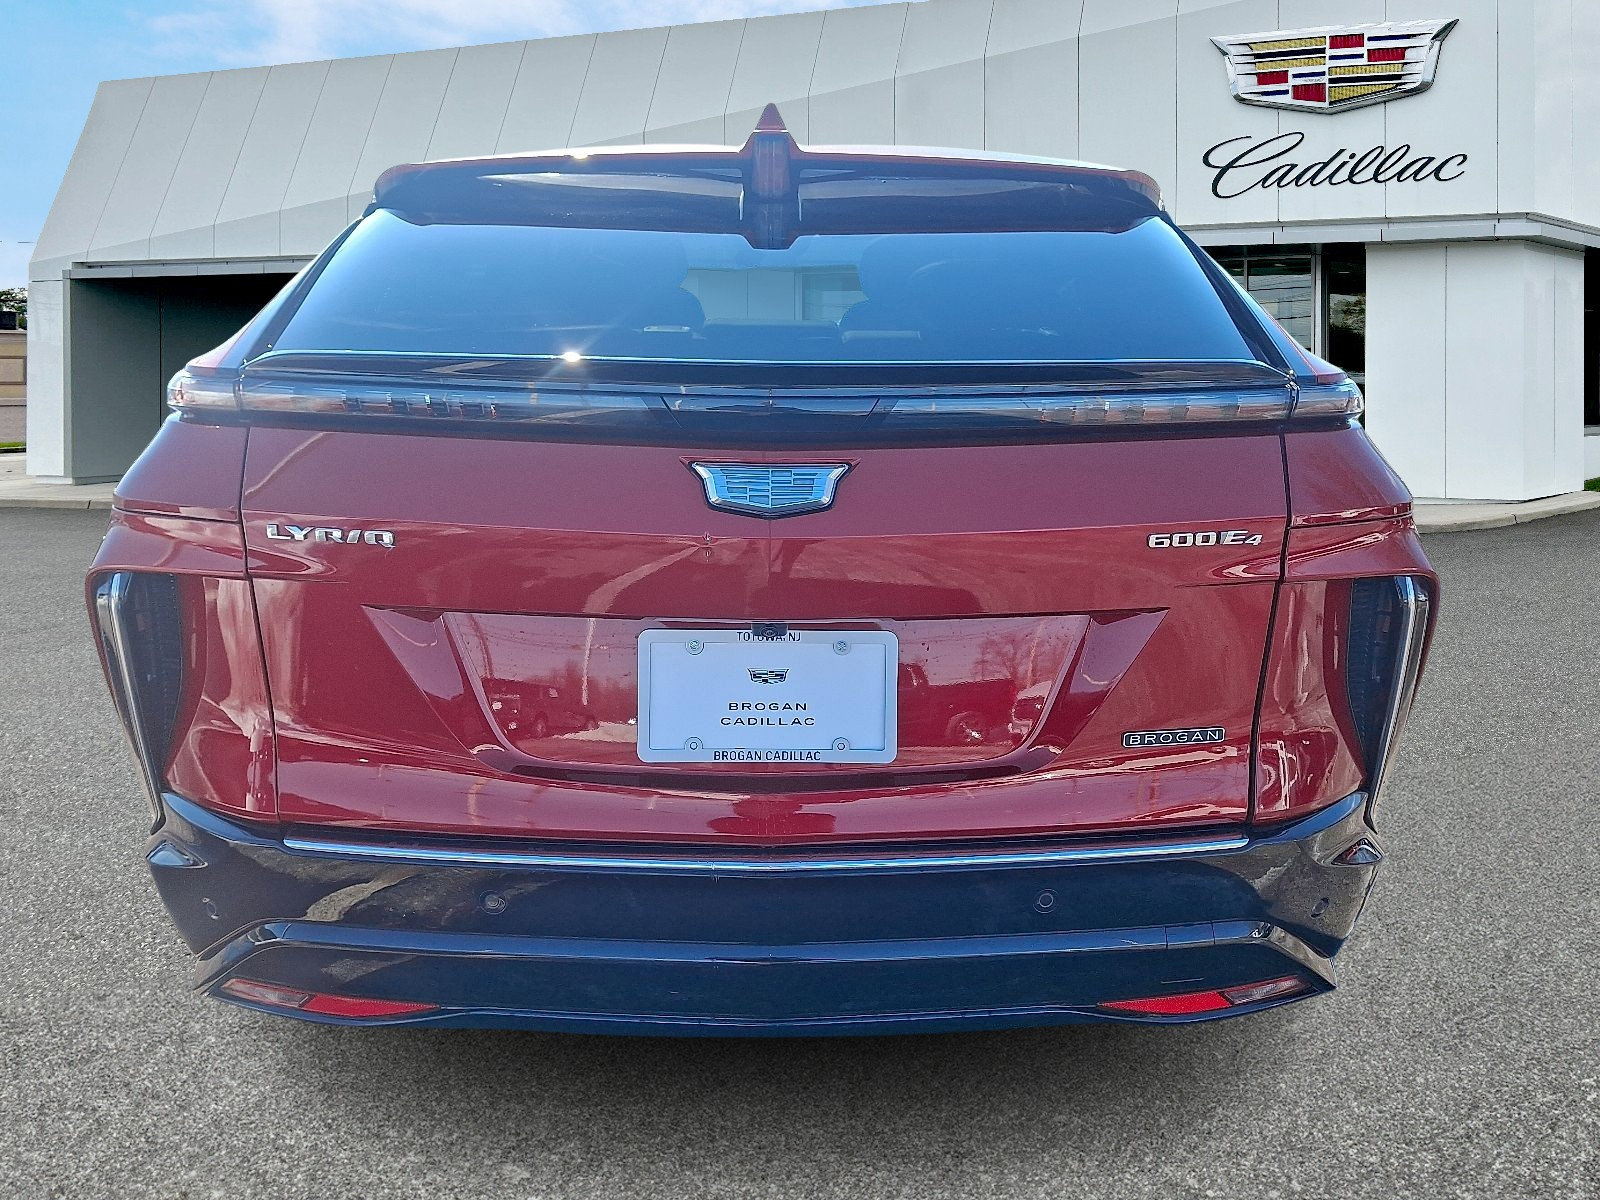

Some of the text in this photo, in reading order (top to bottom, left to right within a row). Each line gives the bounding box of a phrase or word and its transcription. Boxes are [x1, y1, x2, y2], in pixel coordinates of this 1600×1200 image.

[1202, 131, 1468, 199] Cadillac
[266, 523, 396, 548] LYRIQ
[788, 631, 802, 642] NJ
[728, 702, 808, 711] BROGAN
[720, 717, 816, 726] CADILLAC
[1129, 730, 1219, 745] BROGAN
[713, 750, 822, 762] BROGAN CADILLAC
